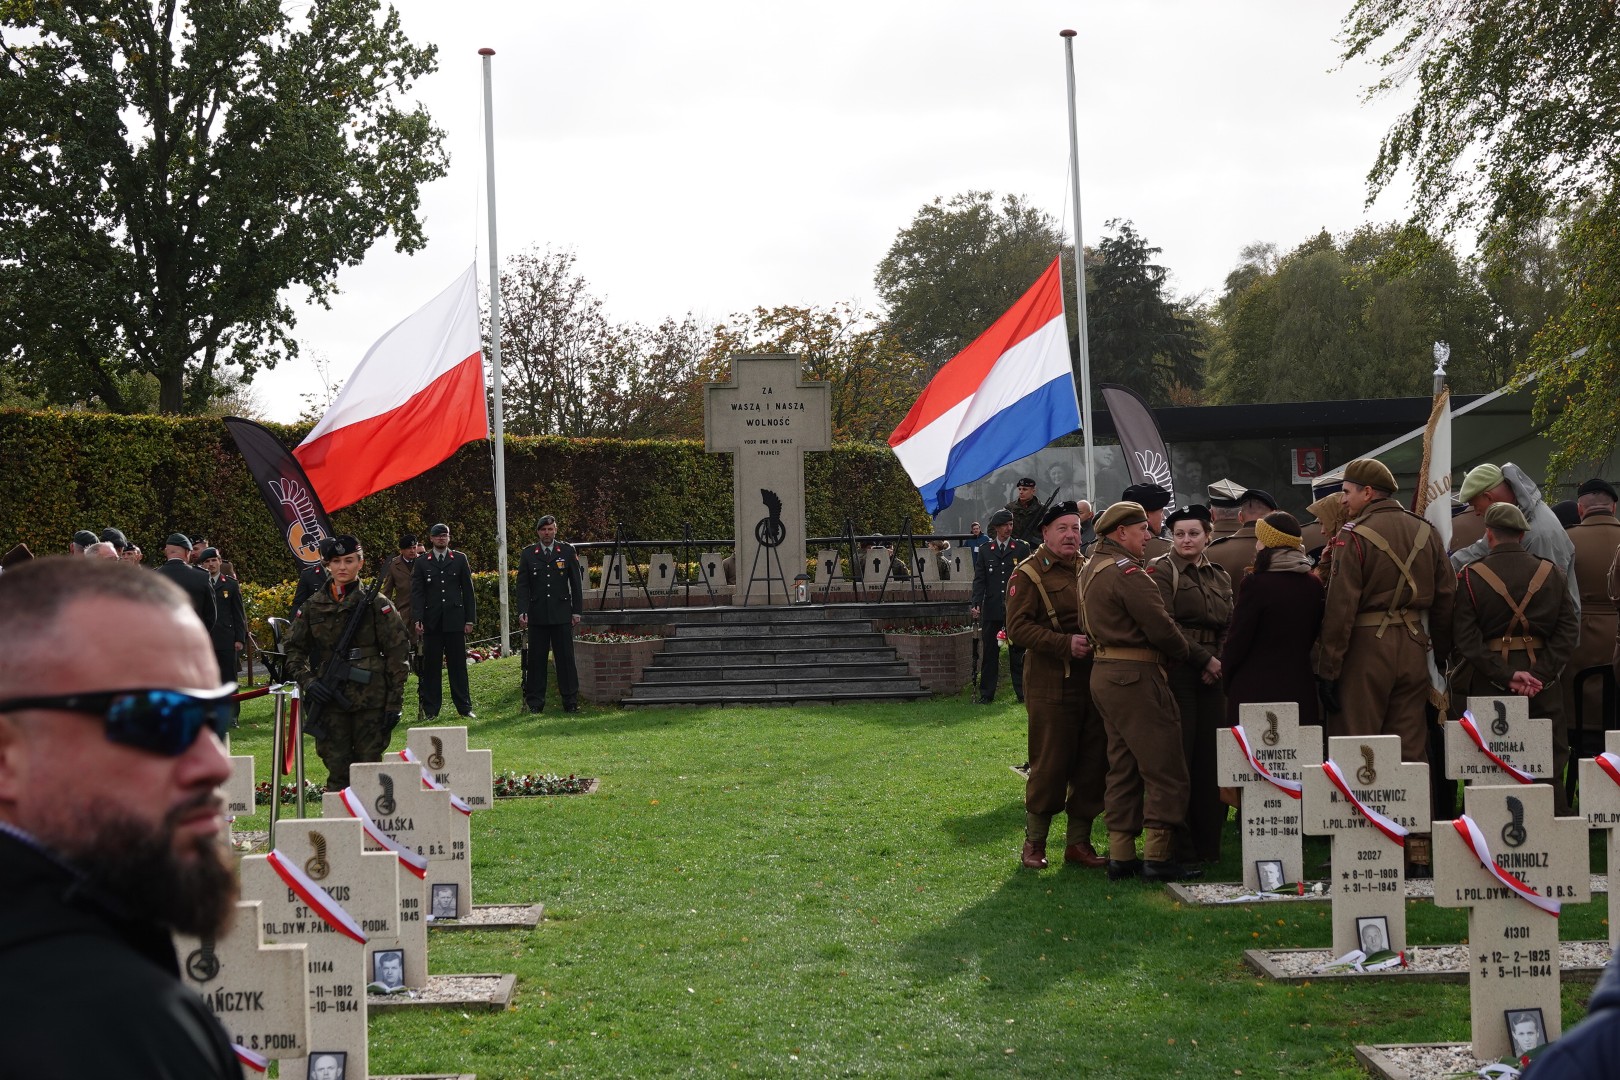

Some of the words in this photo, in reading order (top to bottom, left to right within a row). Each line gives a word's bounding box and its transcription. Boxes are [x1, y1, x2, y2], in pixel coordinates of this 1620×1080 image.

[731, 403, 760, 412] WASZĄ
[775, 402, 805, 412] NASZĄ
[746, 416, 790, 426] WOLNOŚĆ
[1425, 473, 1451, 506] OLO
[1489, 742, 1524, 752] RUCHAŁA
[1256, 749, 1297, 760] CHWISTEK
[1268, 762, 1287, 770] STRZ.
[1264, 800, 1282, 808] 41515
[1358, 850, 1382, 860] 32027
[1496, 852, 1549, 868] GRINHOLZ
[1353, 882, 1396, 892] 31-1-1945
[400, 898, 418, 908] 1910
[296, 907, 312, 918] ST.
[362, 920, 390, 932] PODH.
[1504, 926, 1530, 938] 41301
[1498, 965, 1552, 978] 5-11-1944
[202, 986, 264, 1012] AŃCZYK
